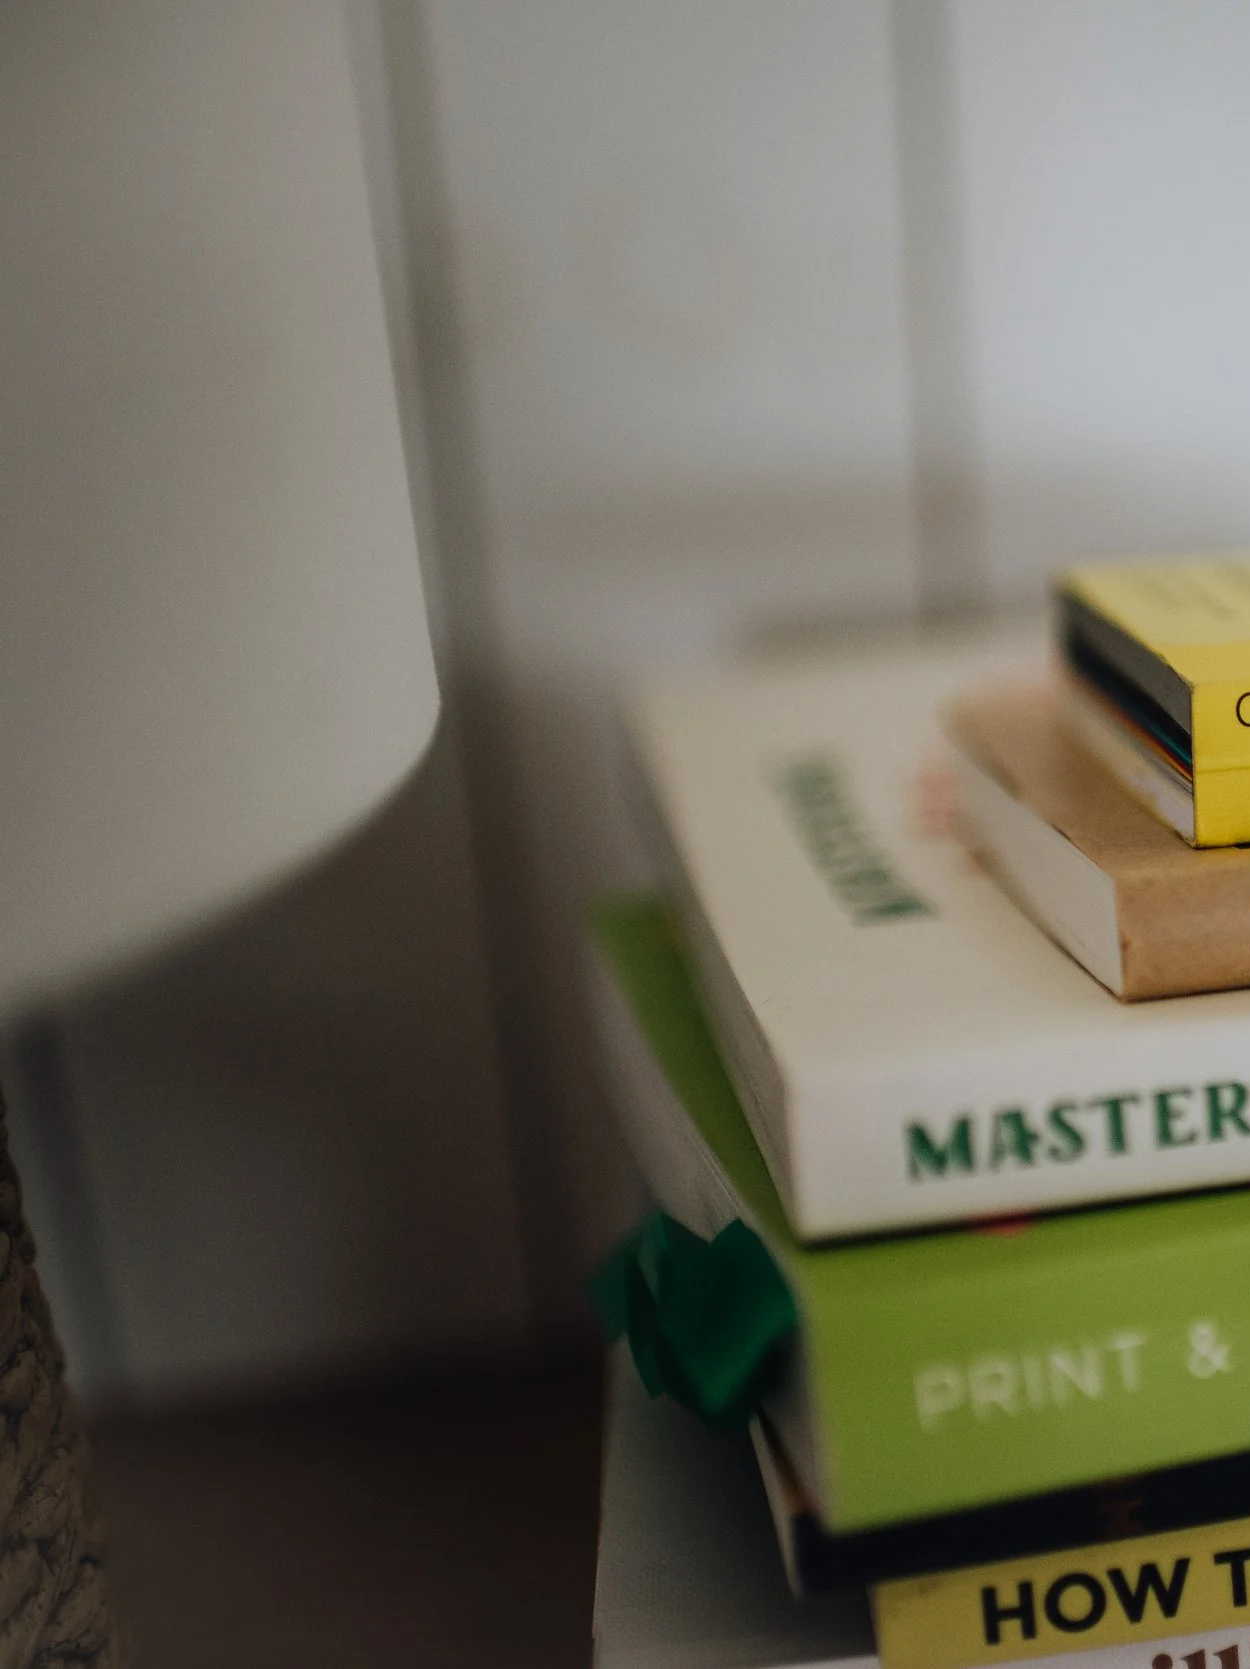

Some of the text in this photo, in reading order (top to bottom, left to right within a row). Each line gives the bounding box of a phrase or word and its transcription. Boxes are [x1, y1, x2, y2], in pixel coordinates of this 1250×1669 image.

[911, 1328, 1147, 1434] PRINT
[1184, 1316, 1232, 1380] &
[980, 1556, 1191, 1646] HOW
